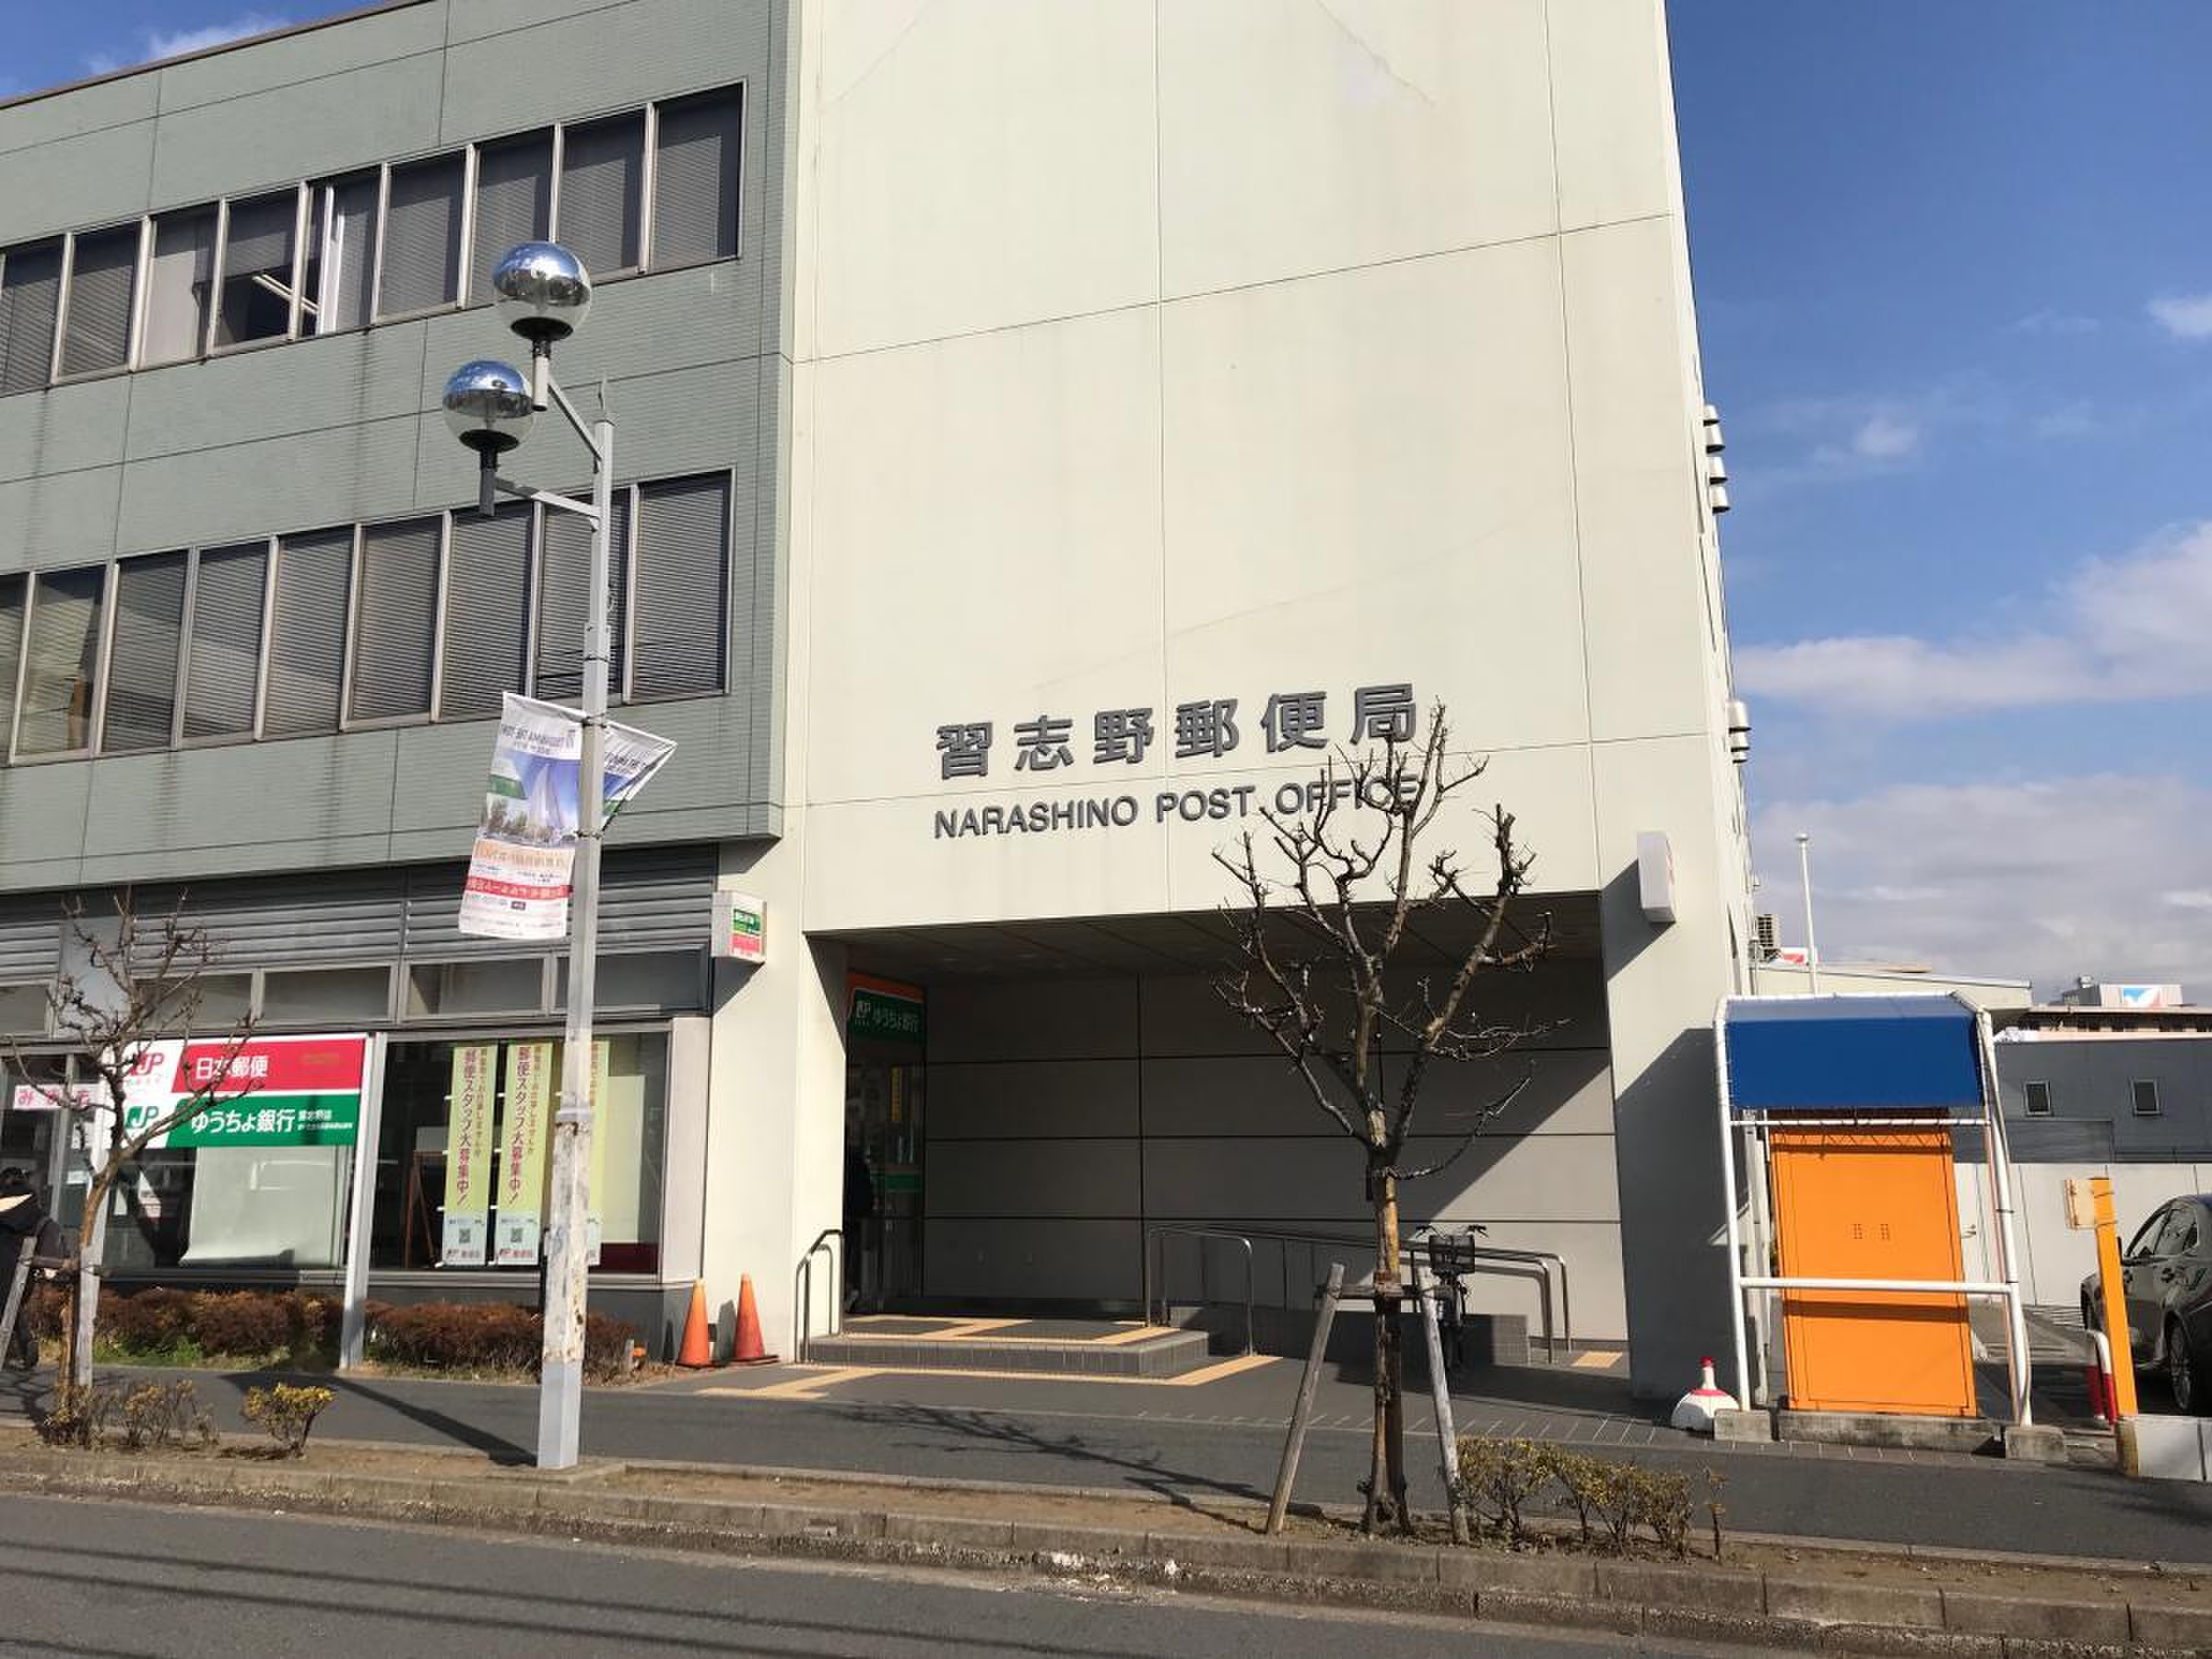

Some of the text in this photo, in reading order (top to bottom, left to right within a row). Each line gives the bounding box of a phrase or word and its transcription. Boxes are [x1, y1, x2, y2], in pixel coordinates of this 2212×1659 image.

[935, 683, 1418, 781] 習志野郵便局
[934, 774, 1419, 840] NARASHINO POST OFFICE
[195, 1055, 269, 1080] 日本郵便
[191, 1107, 295, 1135] ゆうちょ銀行
